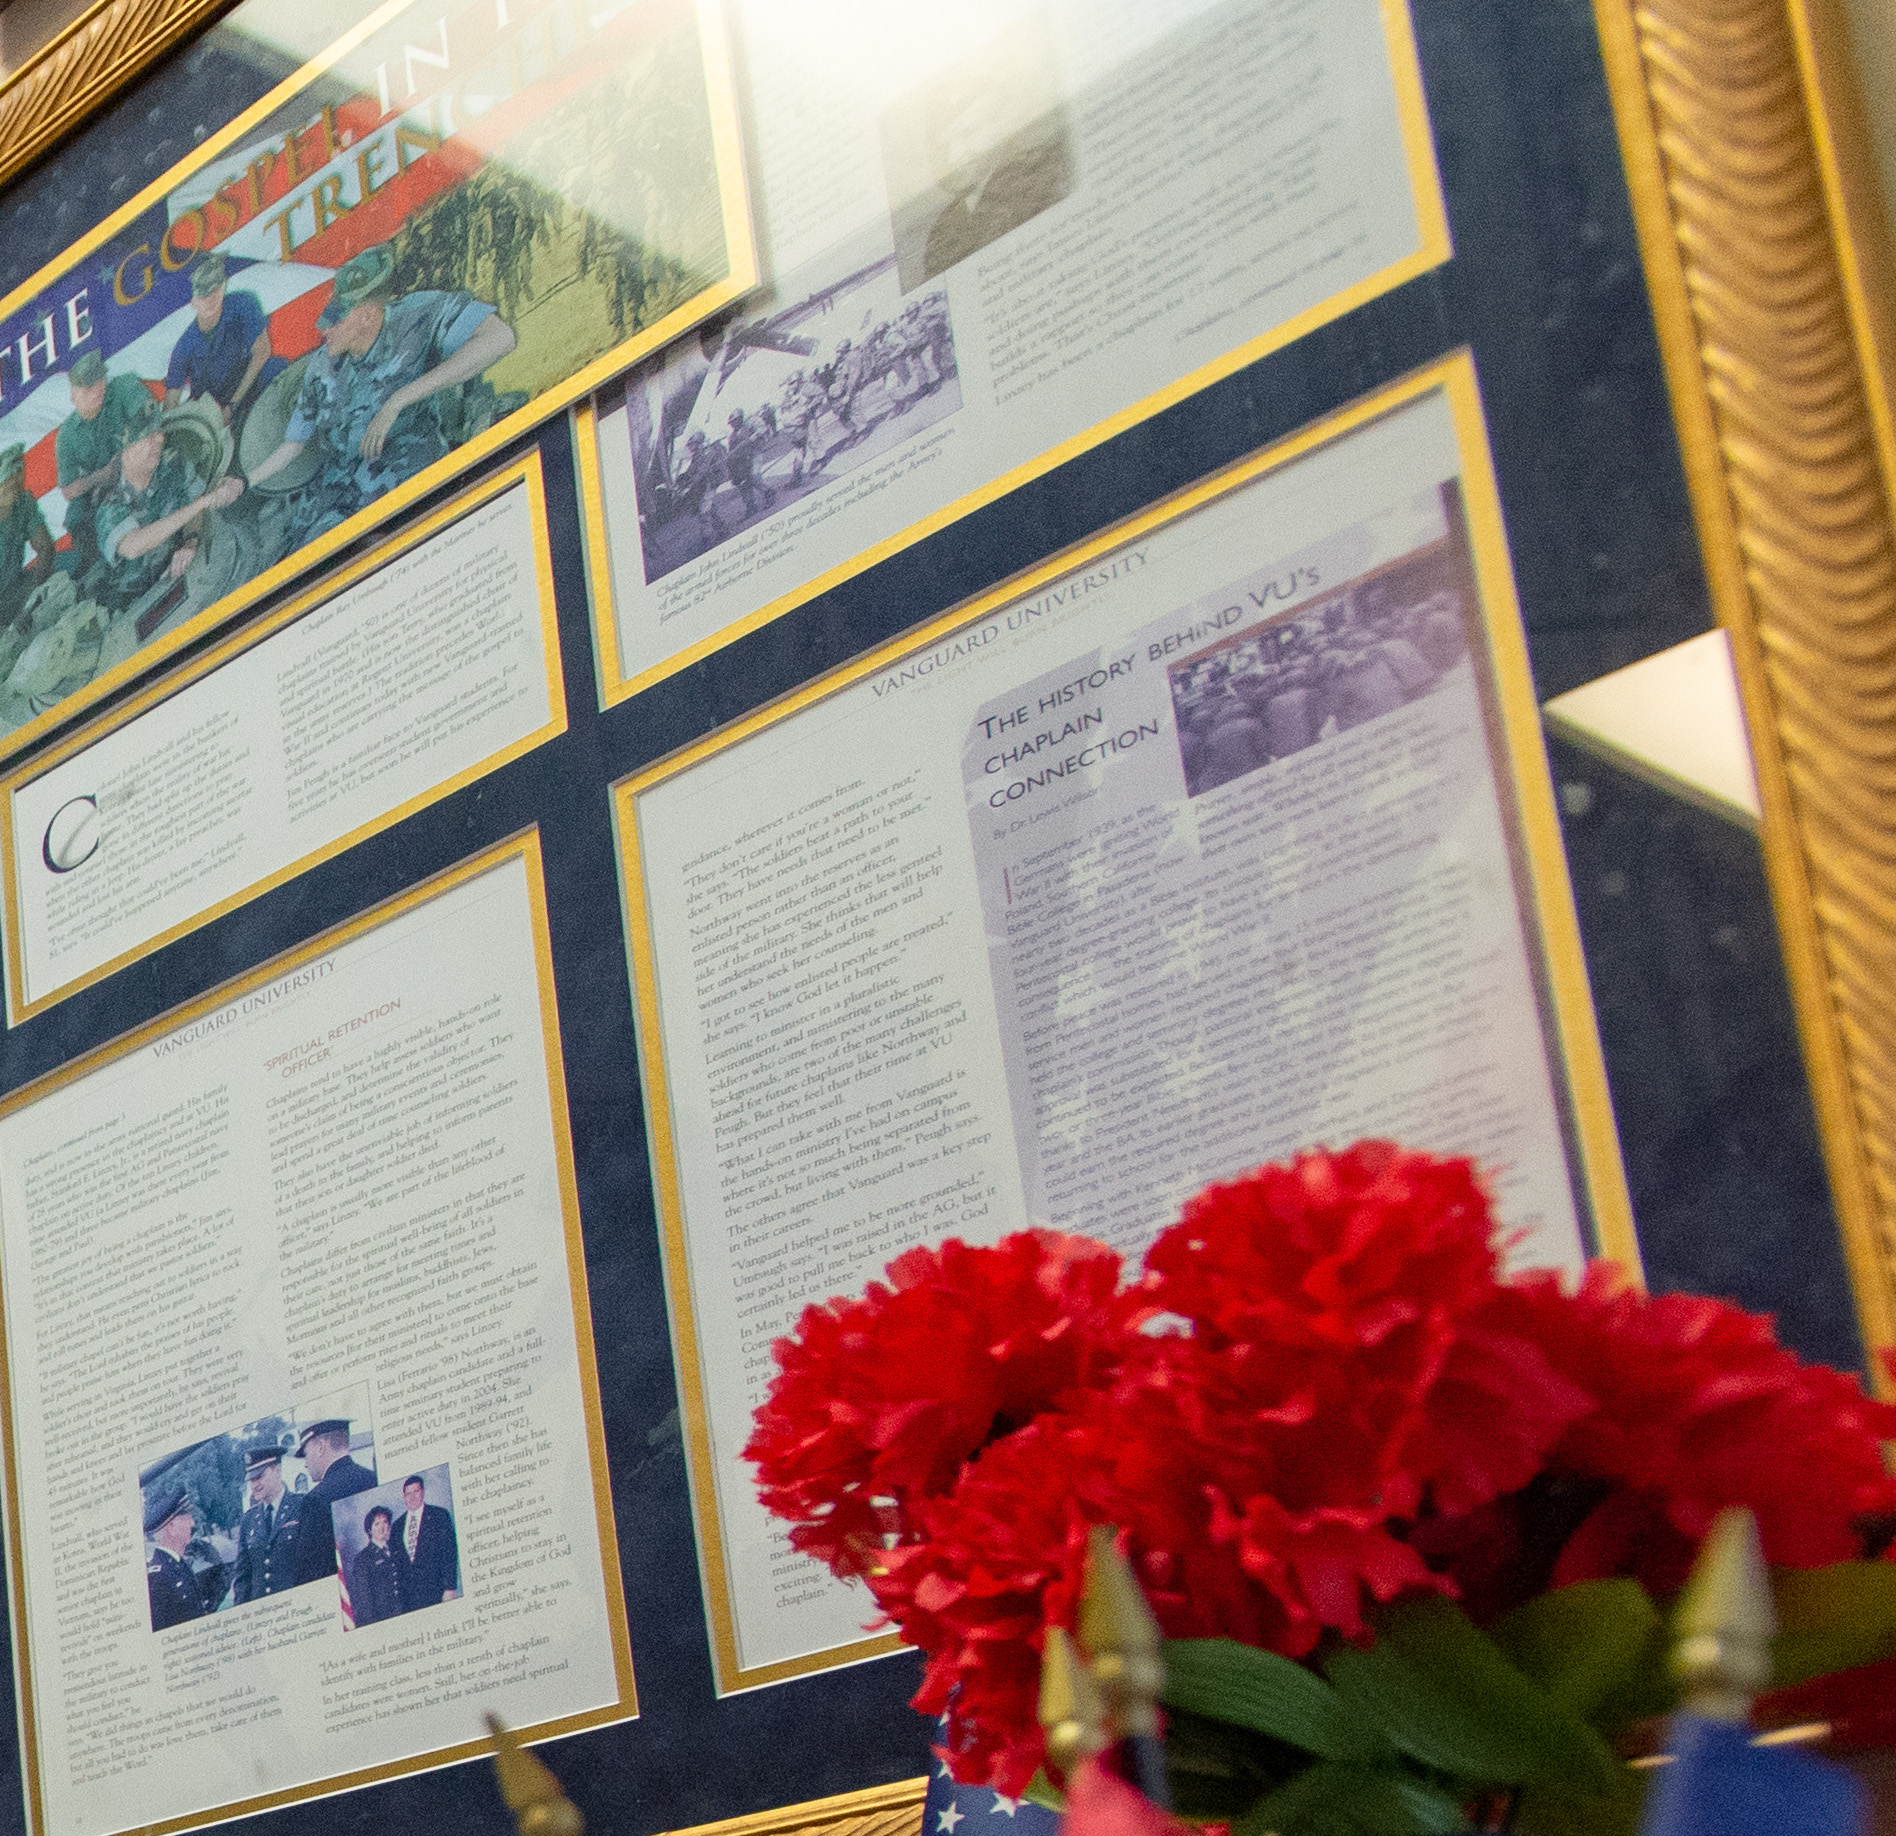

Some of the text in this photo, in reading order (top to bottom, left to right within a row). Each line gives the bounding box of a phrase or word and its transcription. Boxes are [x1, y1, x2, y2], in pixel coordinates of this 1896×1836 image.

[113, 105, 351, 307] GOSPEL
[377, 15, 454, 119] IN
[870, 544, 1152, 701] VANGUARD UNIVERSITY
[977, 702, 1028, 742] THE
[1037, 650, 1138, 714] HISTORY
[1146, 600, 1243, 663] BEHIND
[983, 706, 1103, 776] CHAPLAIN
[988, 716, 1160, 810] CONNECTION
[151, 955, 340, 1059] VANGUARD UNIVERSITY
[327, 996, 401, 1042] RETENTION
